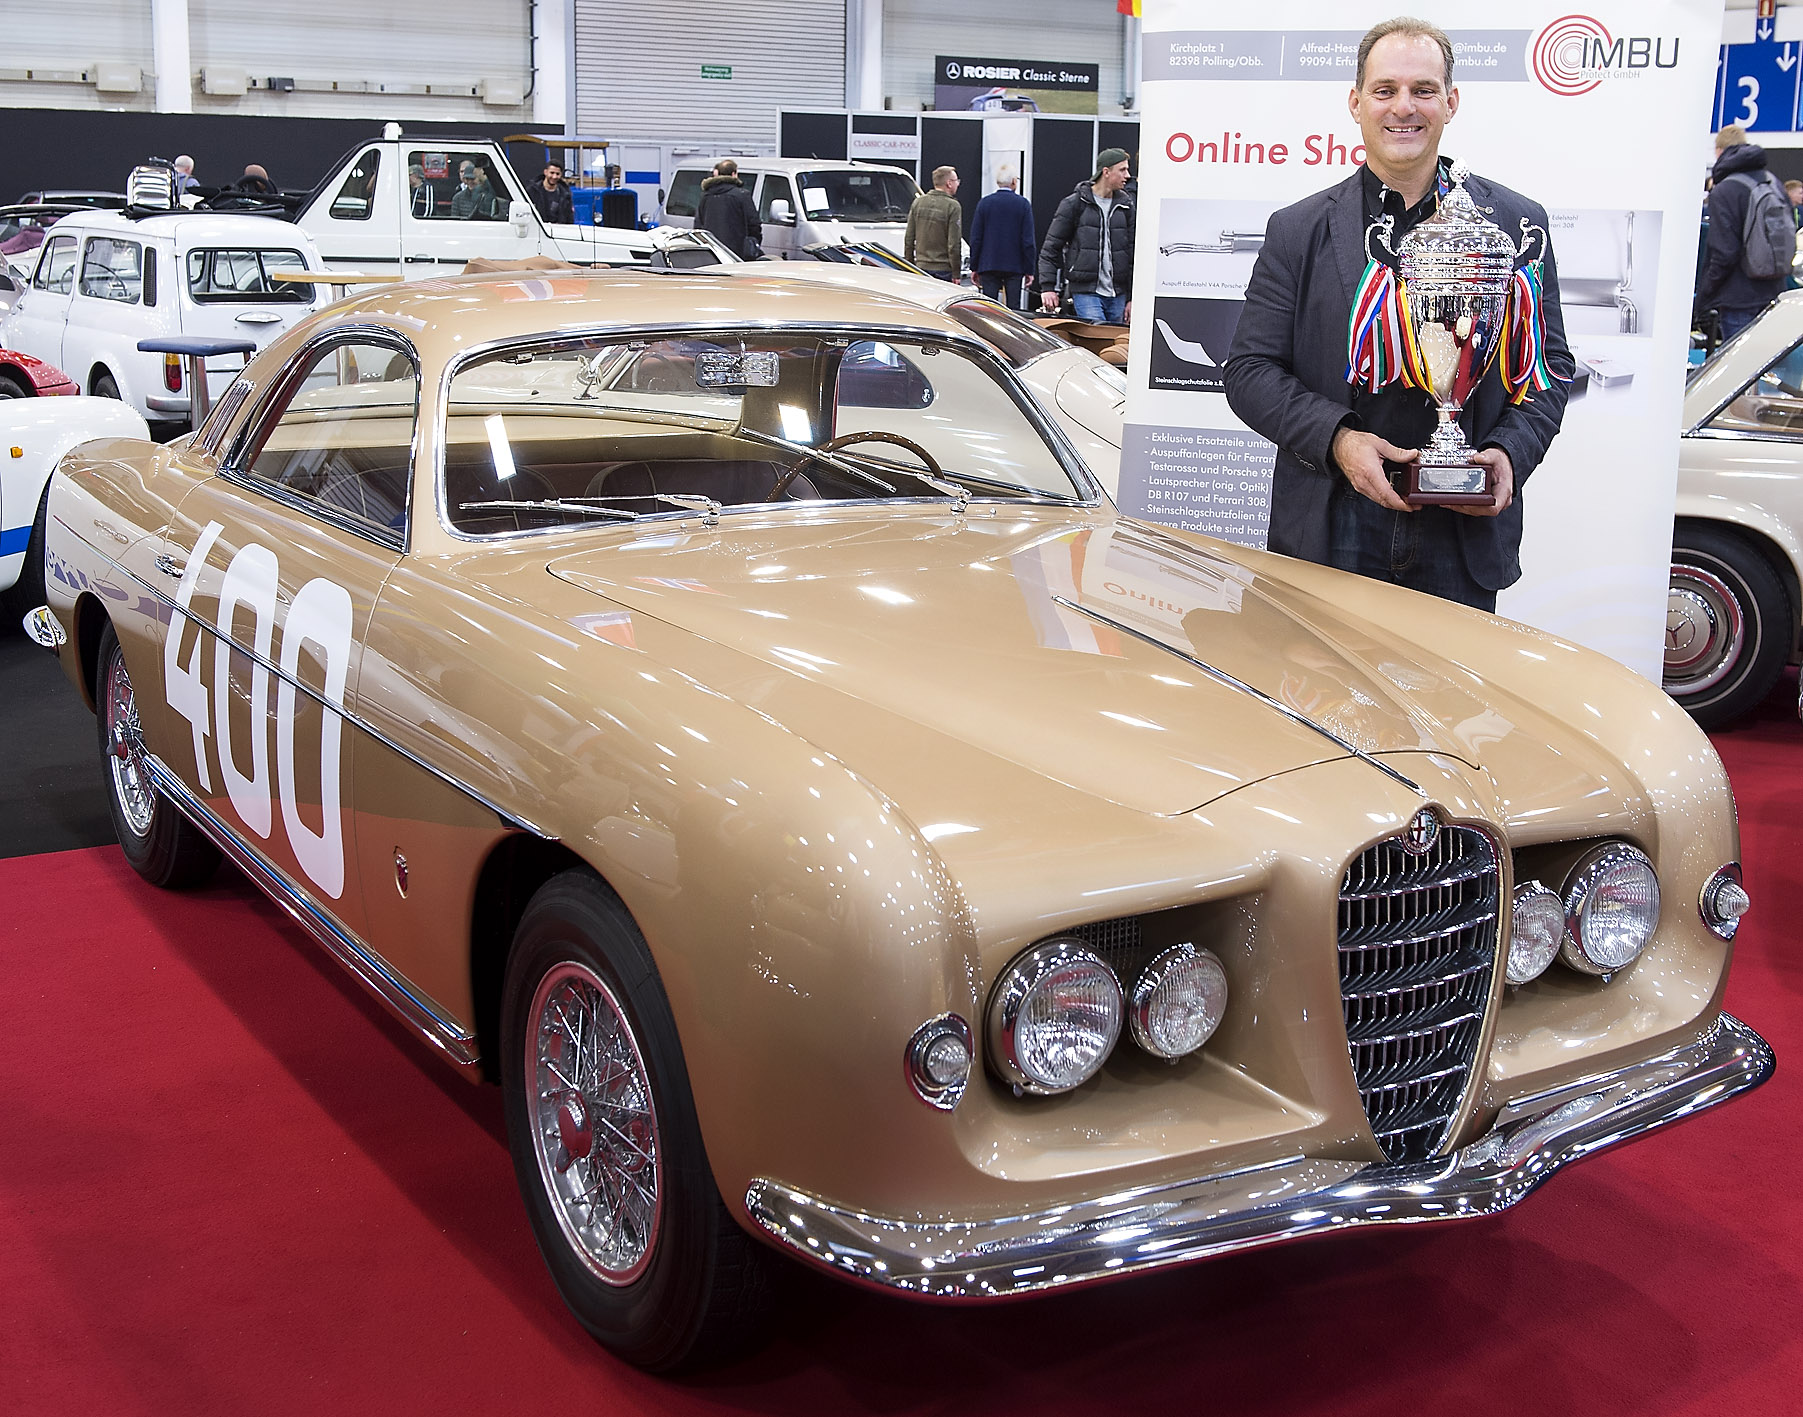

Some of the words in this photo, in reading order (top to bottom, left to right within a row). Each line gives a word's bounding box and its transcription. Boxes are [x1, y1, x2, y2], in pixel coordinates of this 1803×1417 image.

[1170, 43, 1216, 54] Kirchplatz
[1220, 43, 1224, 53] 1
[1299, 43, 1360, 53] Alfred-Hess
[1453, 41, 1507, 54] @imbu.de
[1581, 37, 1680, 69] IMBU
[1169, 56, 1200, 66] 82398
[1202, 55, 1264, 68] Polling/Obb.
[1299, 56, 1332, 66] 99094
[963, 65, 1021, 80] ROSIER
[1023, 69, 1057, 82] Classic
[1058, 71, 1090, 84] Sterne
[1580, 70, 1611, 79] Protect
[1613, 70, 1641, 79] GmbH
[1734, 75, 1760, 129] 3
[1165, 132, 1289, 165] Online
[1151, 432, 1194, 445] Exklusive
[1196, 434, 1245, 448] Ersatzteile
[1247, 439, 1273, 449] unter
[1150, 447, 1225, 461] Auspuffanlagen
[1228, 451, 1242, 462] für
[1149, 460, 1198, 473] Testarossa
[1200, 465, 1219, 475] und
[1222, 465, 1259, 478] Porsche
[1148, 475, 1210, 489] Lautsprecher
[1212, 479, 1236, 492] (orig.
[1239, 481, 1269, 495] Optik)
[1147, 489, 1162, 499] DB
[1164, 490, 1190, 501] R107
[1192, 493, 1211, 503] und
[1213, 494, 1245, 505] Ferrari
[1247, 496, 1270, 509] 308,
[1146, 503, 1255, 520] Steinschlagschutzfolien
[1181, 520, 1223, 533] Produkte
[1224, 524, 1245, 534] sind
[163, 519, 353, 899] 400
